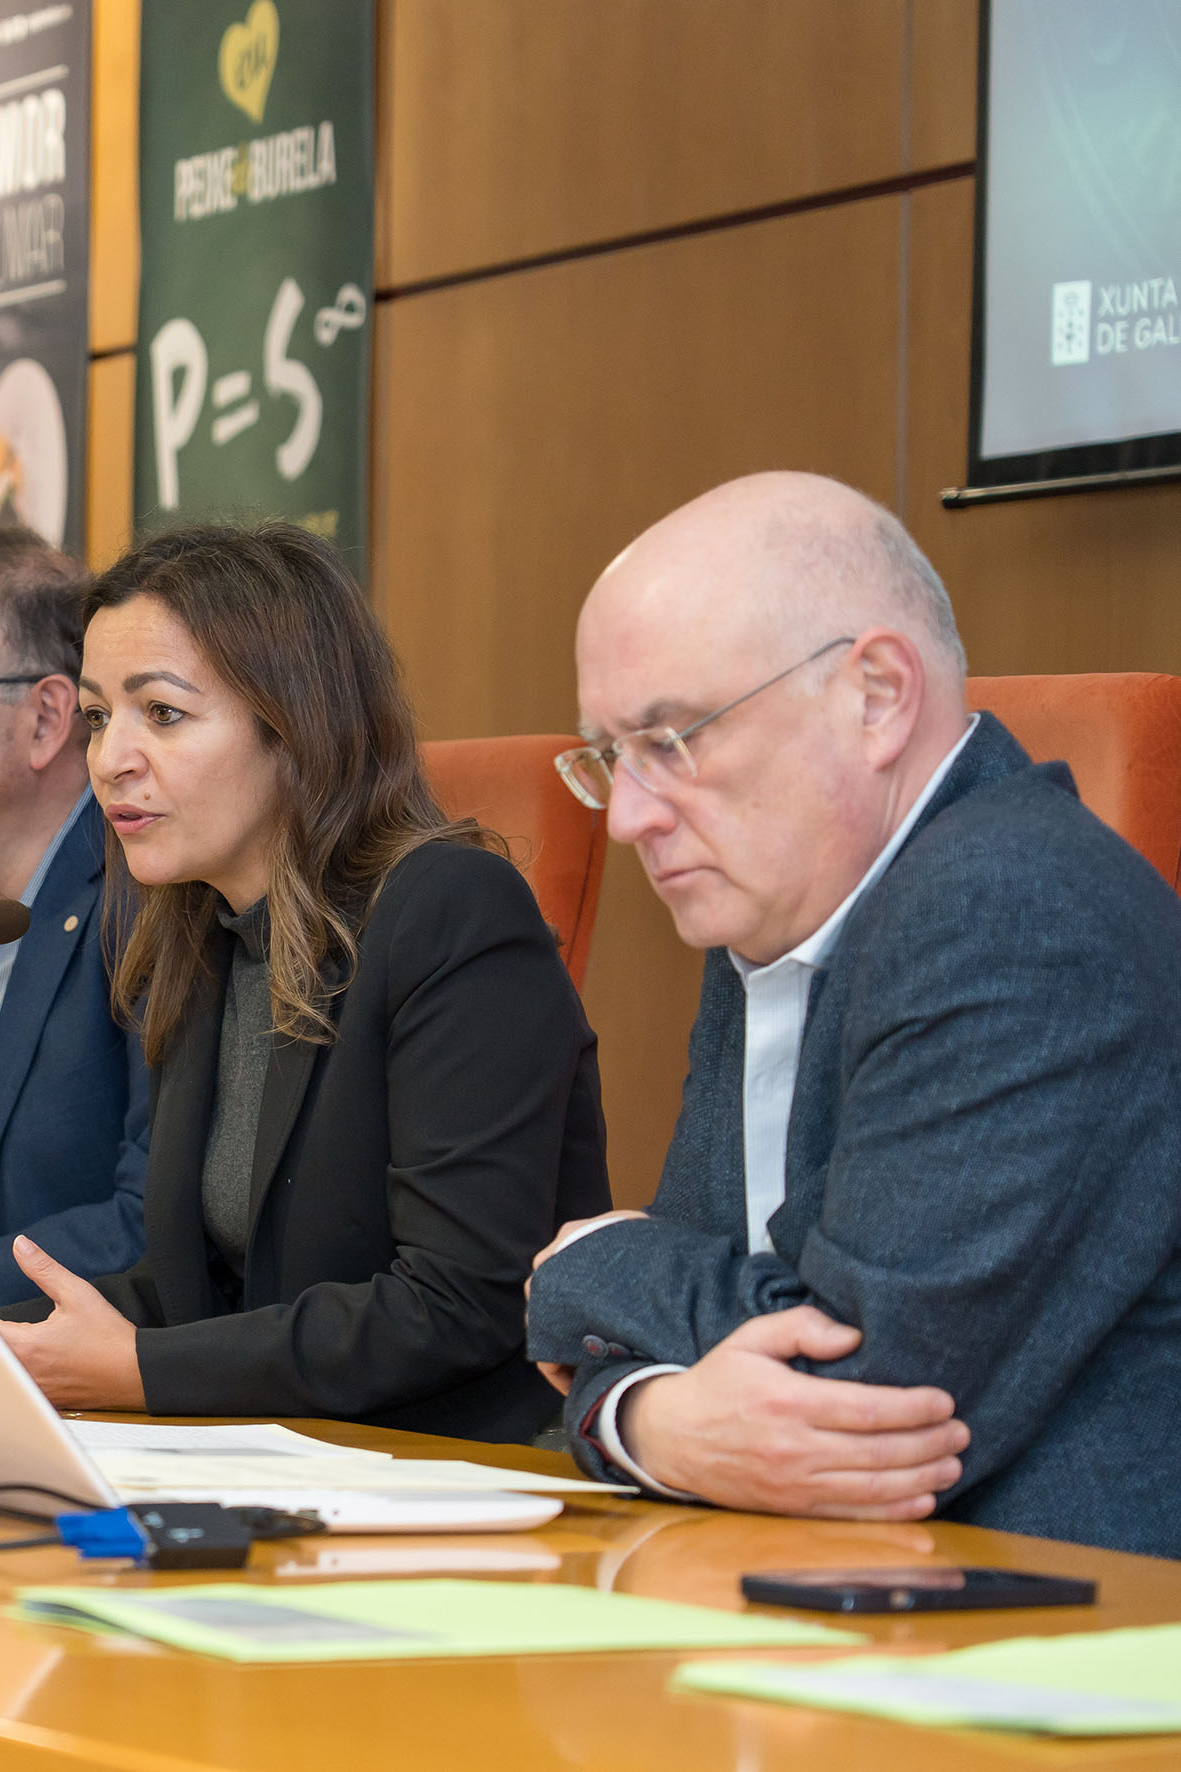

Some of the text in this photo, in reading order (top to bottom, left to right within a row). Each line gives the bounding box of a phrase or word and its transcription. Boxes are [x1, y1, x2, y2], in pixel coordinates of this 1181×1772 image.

[248, 119, 337, 205] BURELA
[1098, 277, 1178, 317] XUNTA
[1096, 311, 1181, 356] DE GAL
